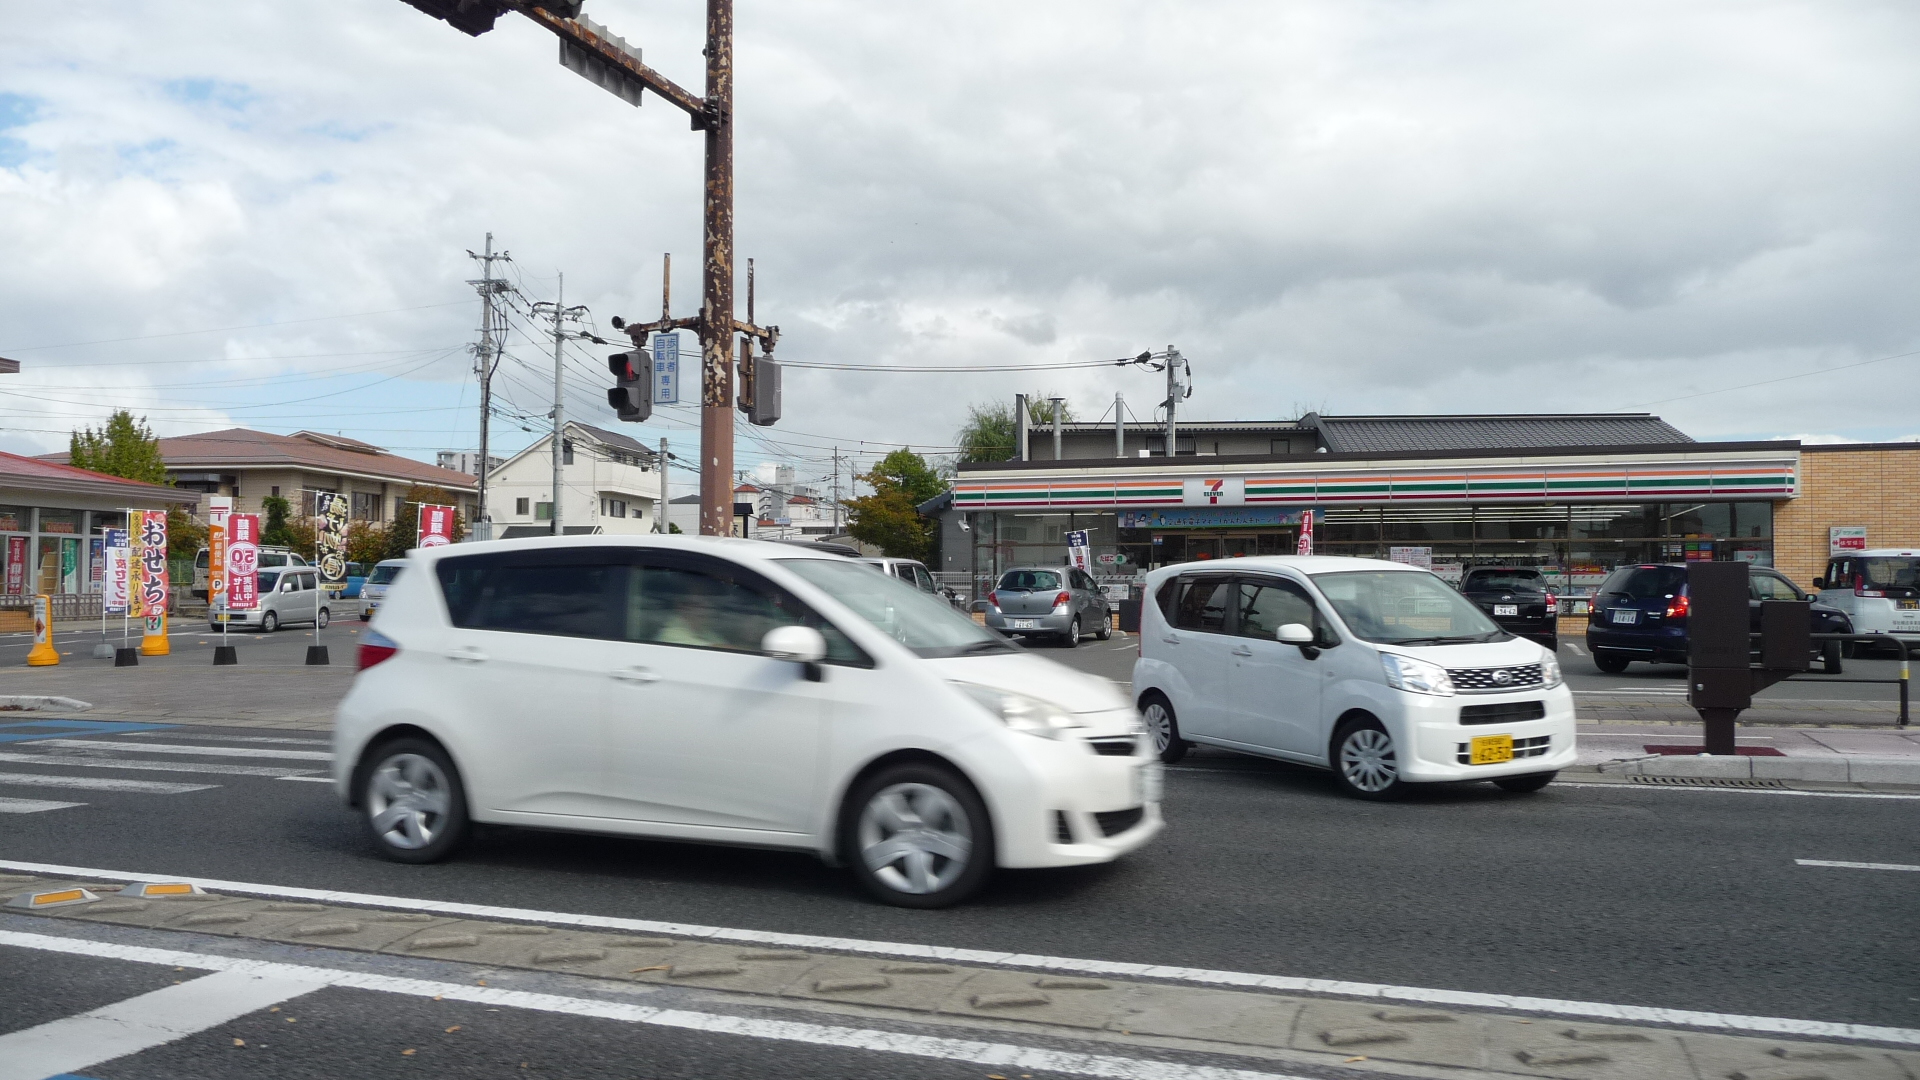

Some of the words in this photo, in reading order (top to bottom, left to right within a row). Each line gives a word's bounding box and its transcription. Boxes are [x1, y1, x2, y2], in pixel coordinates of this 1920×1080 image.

[656, 338, 666, 372] 自転車
[666, 338, 676, 373] 歩行者
[660, 375, 670, 399] 専用
[142, 520, 165, 604] おせち
[214, 542, 222, 566] 郵便局
